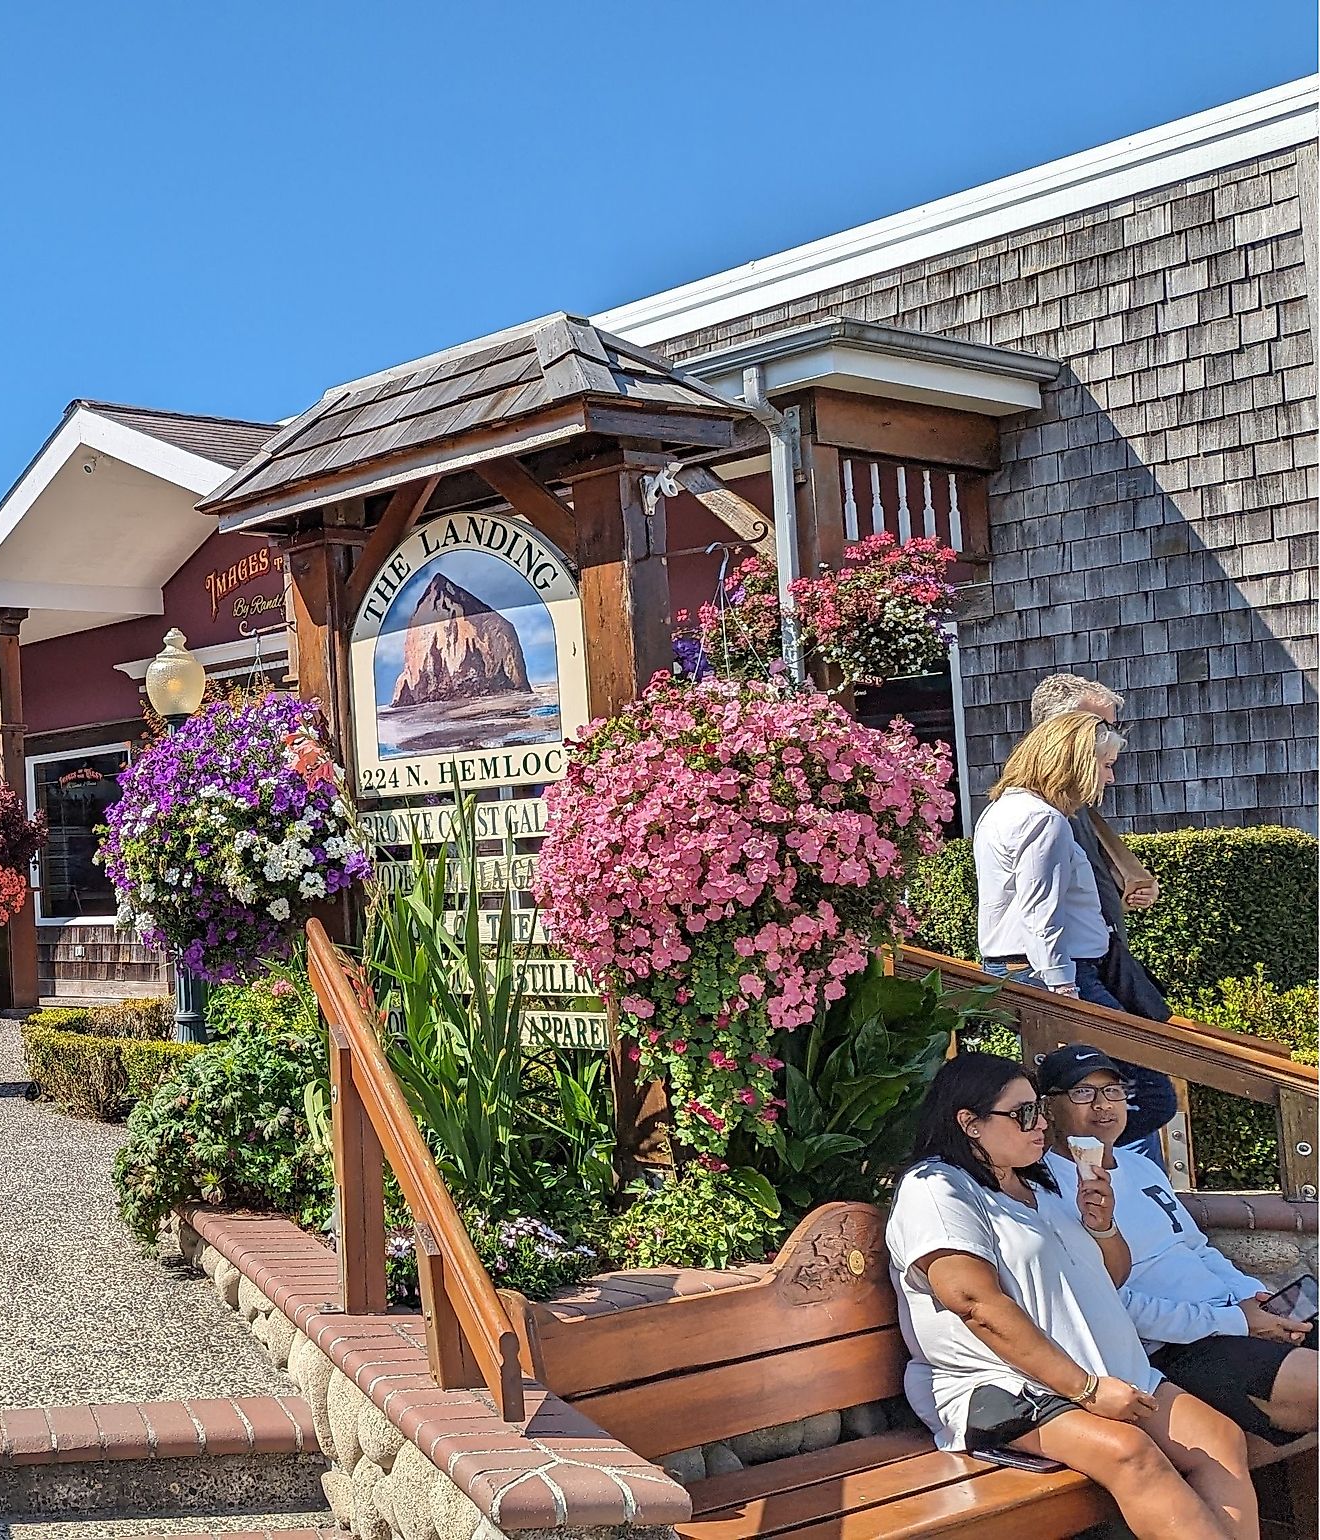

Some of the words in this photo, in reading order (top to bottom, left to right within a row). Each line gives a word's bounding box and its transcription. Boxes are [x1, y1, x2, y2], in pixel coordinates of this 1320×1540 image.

[205, 548, 270, 618] IMAGES
[363, 552, 411, 624] THE
[417, 516, 560, 592] LANDING
[233, 597, 251, 619] By
[362, 767, 399, 791] 224
[406, 764, 429, 788] N.
[438, 748, 563, 785] HEMLOC
[1141, 1184, 1184, 1235] P
